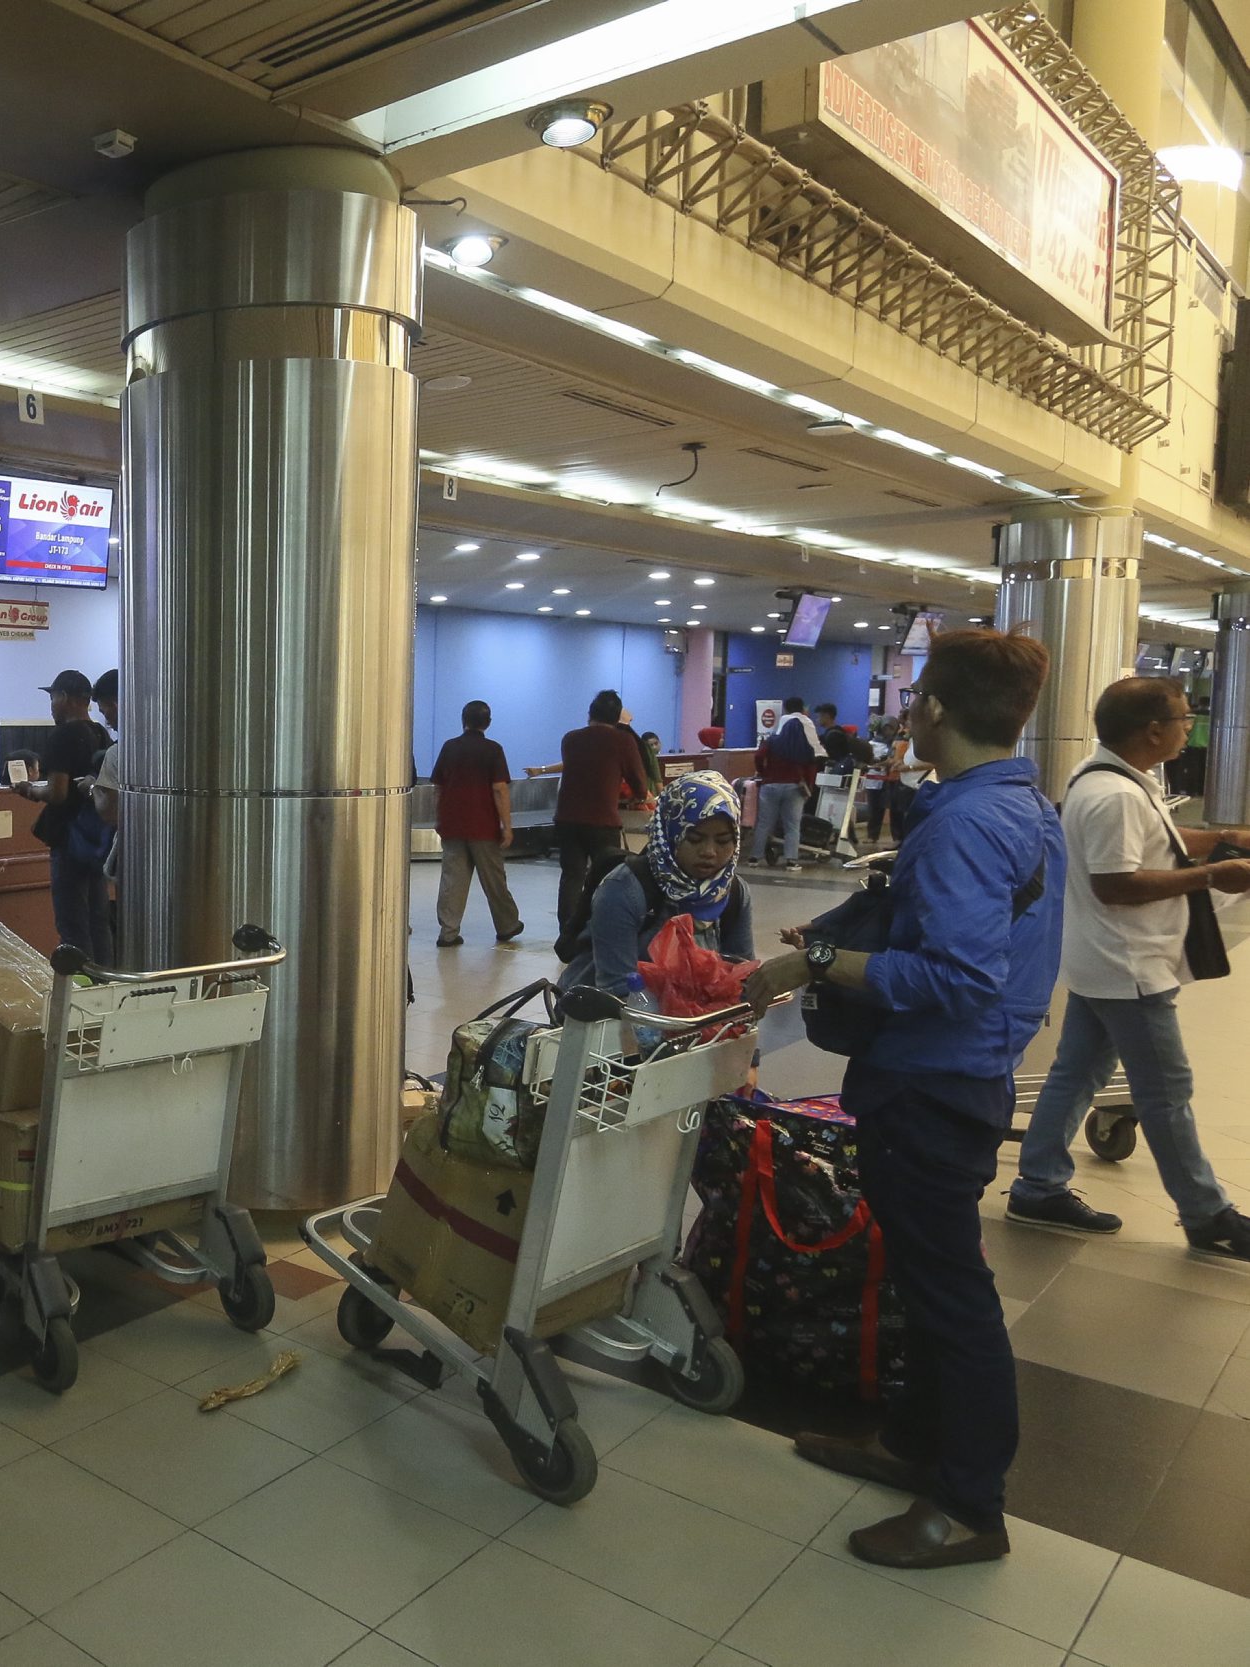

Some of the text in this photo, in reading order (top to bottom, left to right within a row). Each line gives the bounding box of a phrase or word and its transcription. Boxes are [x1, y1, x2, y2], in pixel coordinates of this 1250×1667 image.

[824, 61, 940, 194] ADVERTISEMENT
[26, 393, 37, 420] 6
[447, 478, 454, 497] 8
[18, 493, 104, 517] Lion air
[35, 531, 85, 545] Bandar Lampung
[48, 546, 69, 555] JT-173
[20, 612, 48, 624] Group
